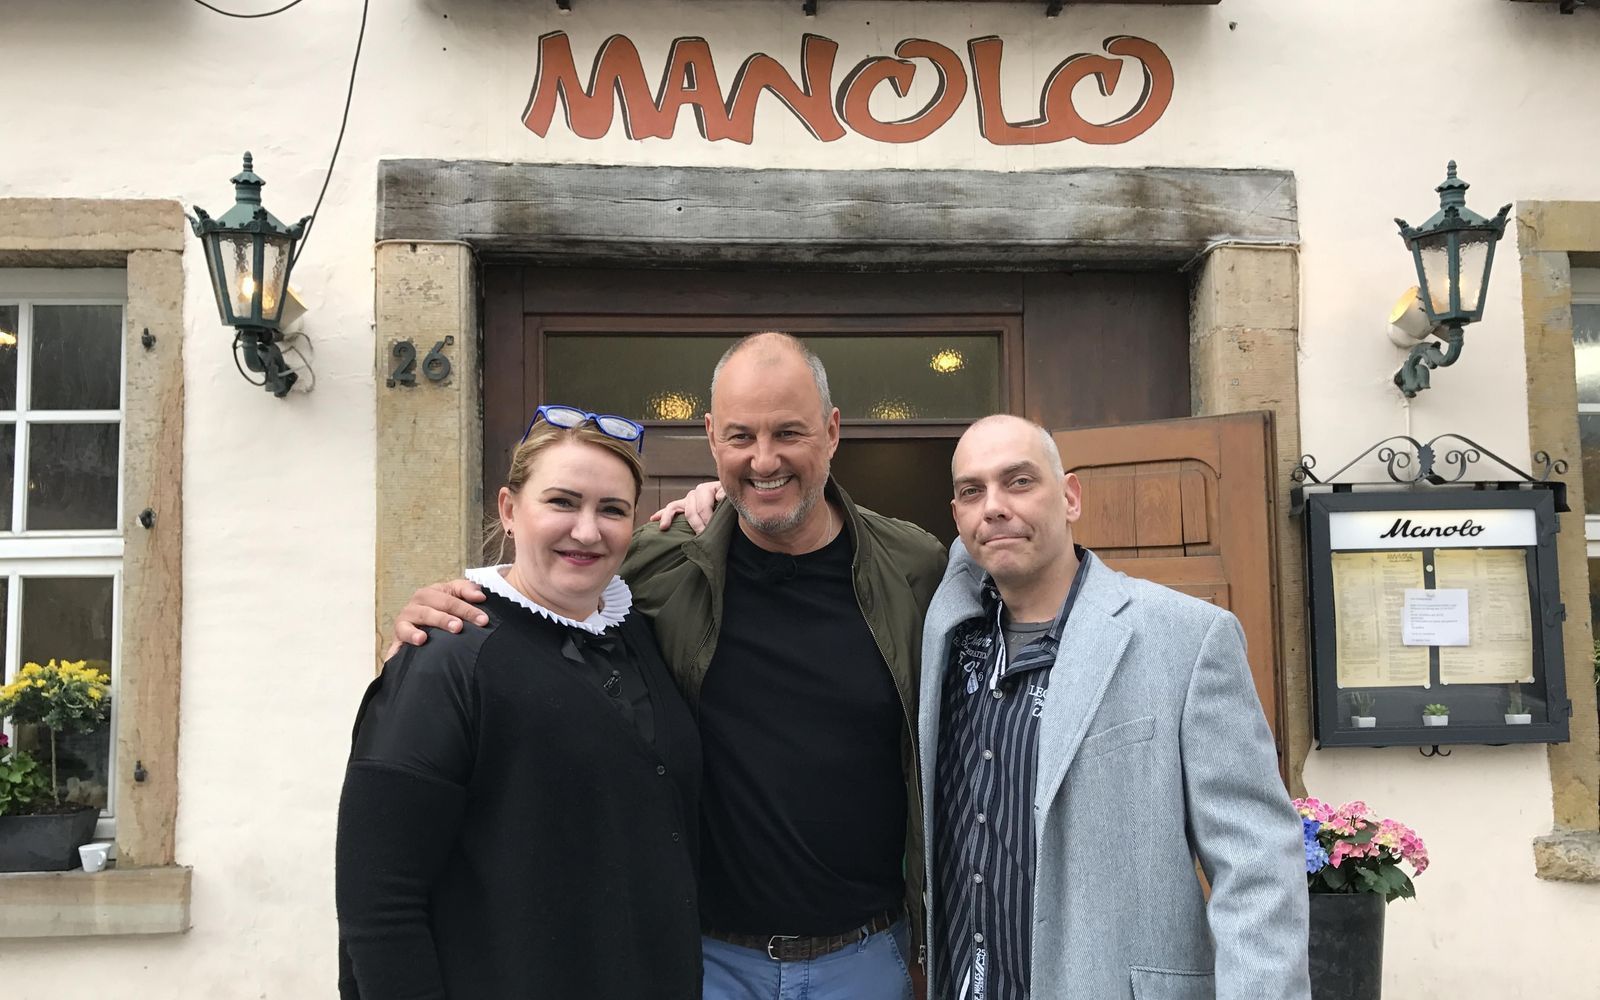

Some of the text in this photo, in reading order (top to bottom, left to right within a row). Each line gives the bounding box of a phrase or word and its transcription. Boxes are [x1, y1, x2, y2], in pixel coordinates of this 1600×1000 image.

[521, 31, 1174, 145] MANOLO
[386, 335, 455, 388] 26
[1380, 518, 1486, 539] Manolo
